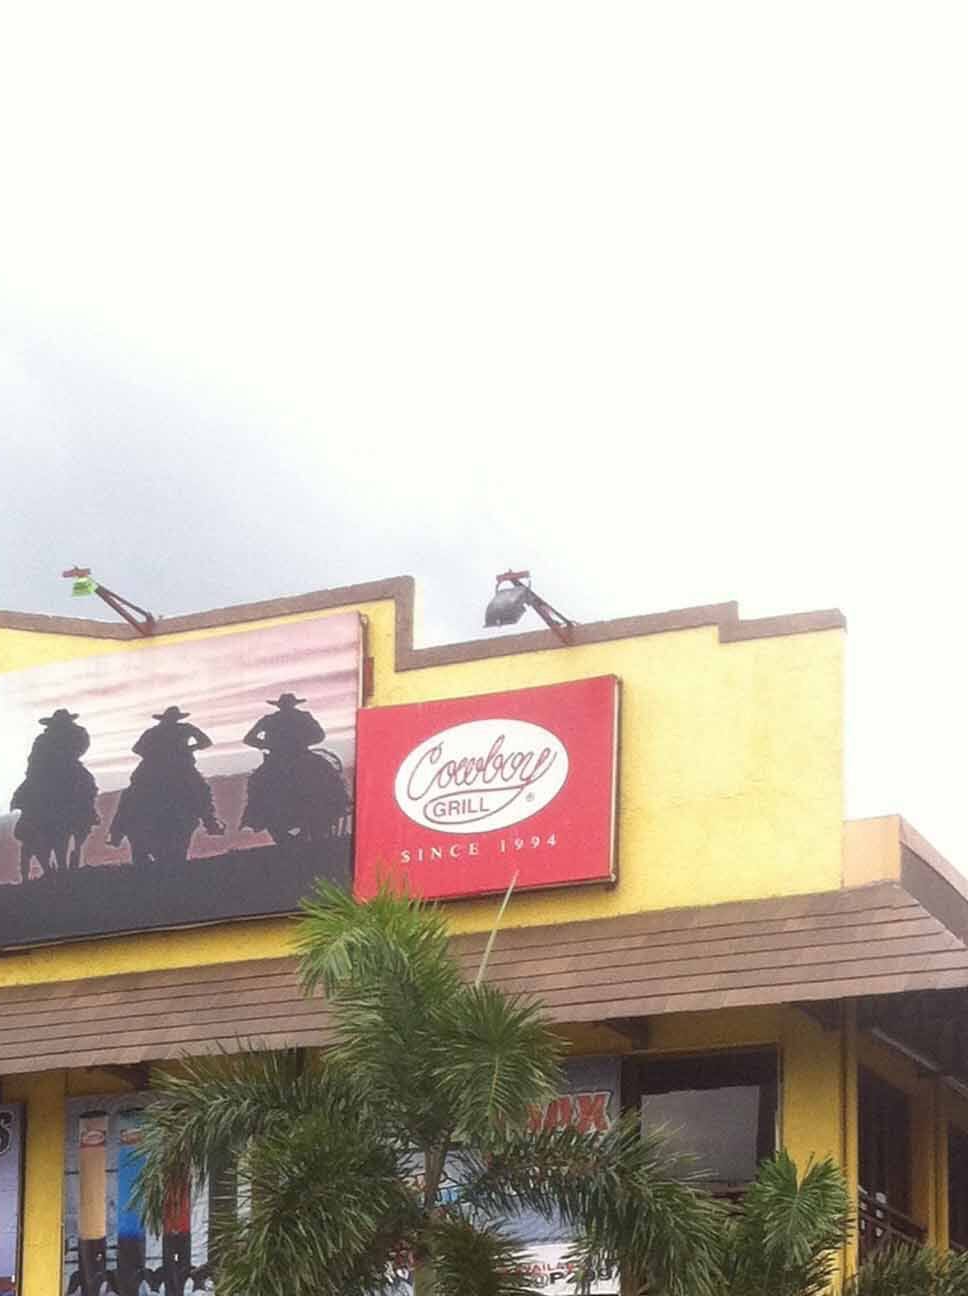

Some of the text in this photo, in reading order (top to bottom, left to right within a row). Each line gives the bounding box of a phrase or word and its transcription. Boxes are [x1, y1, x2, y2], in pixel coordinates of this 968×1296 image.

[407, 734, 558, 801] Cowboy
[432, 797, 490, 818] GRILL
[400, 833, 558, 863] SINCE 1994
